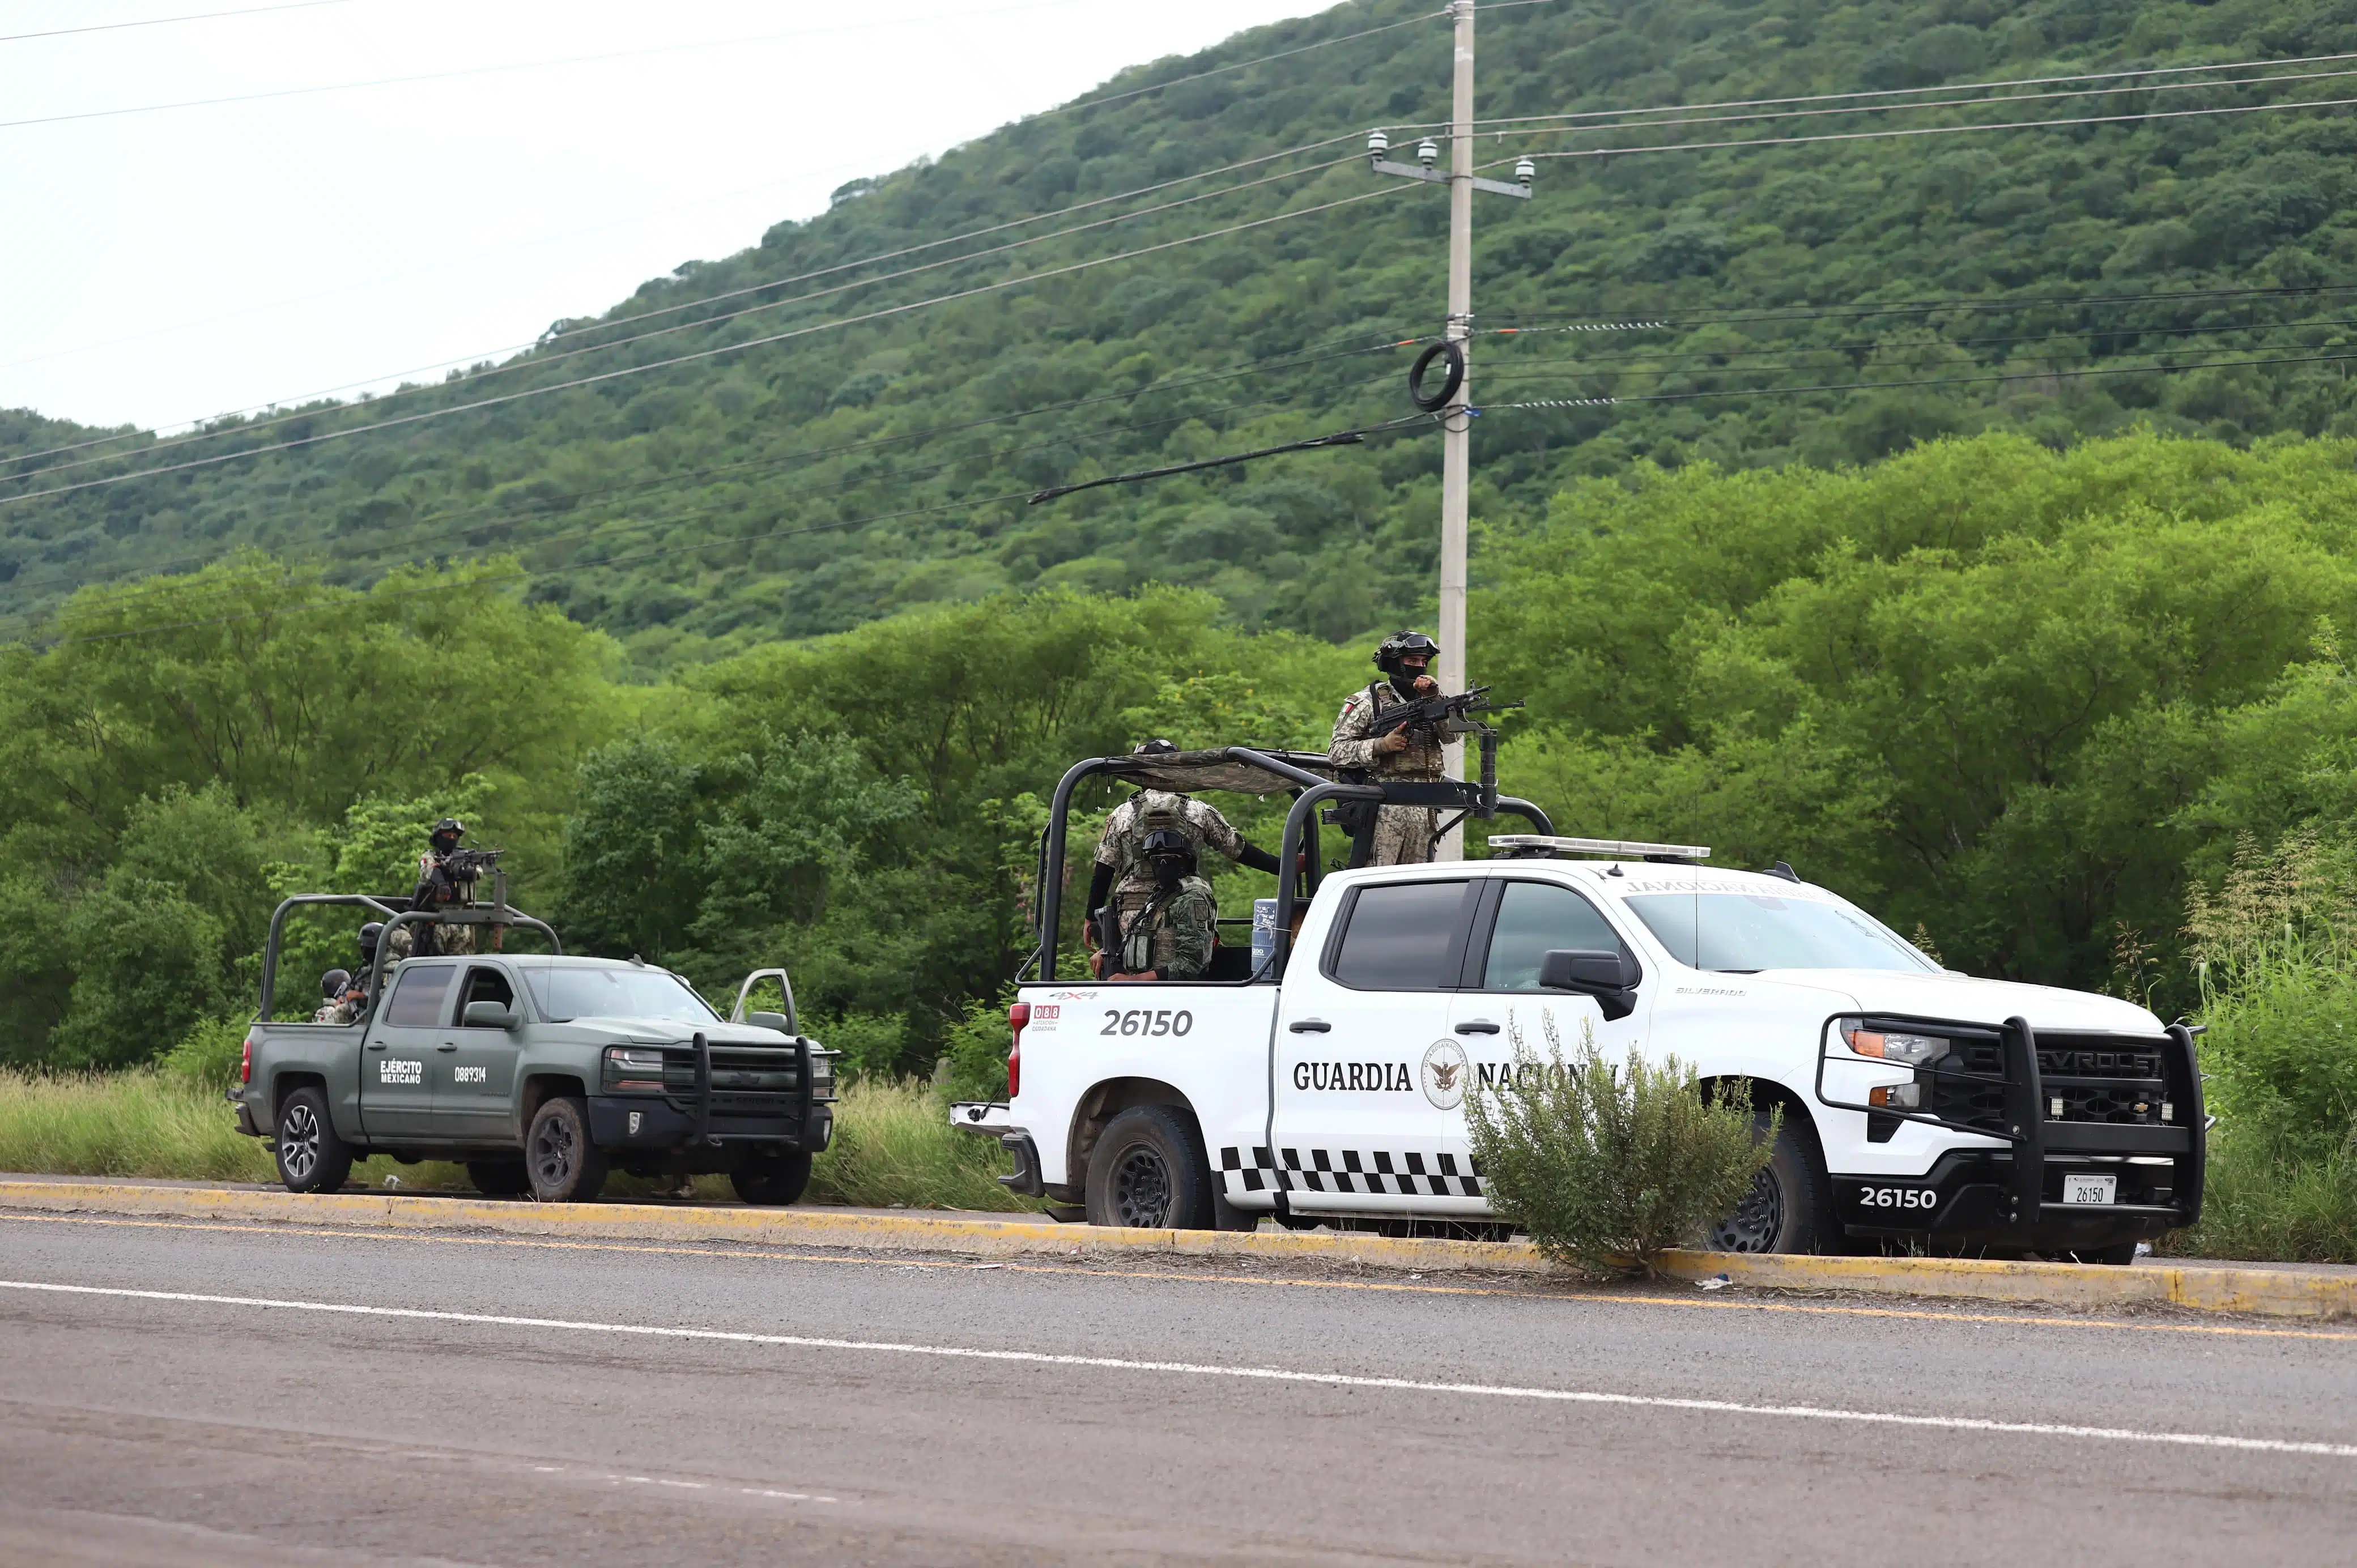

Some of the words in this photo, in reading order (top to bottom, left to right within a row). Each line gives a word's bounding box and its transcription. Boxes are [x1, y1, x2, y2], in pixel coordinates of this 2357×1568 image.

[1035, 1007, 1058, 1018] 088
[1100, 1010, 1193, 1037] 26150
[1424, 1042, 1444, 1068] GUARDIA
[1445, 1043, 1466, 1069] NACIONAL
[380, 1058, 422, 1074] EJÉRCITO
[454, 1067, 486, 1083] 0889314
[381, 1073, 421, 1084] MEXICANO
[1294, 1062, 1413, 1091] GUARDIA
[1477, 1063, 1624, 1092] NACIONL
[1860, 1187, 1937, 1209] 26150
[2077, 1187, 2103, 1202] 26150
